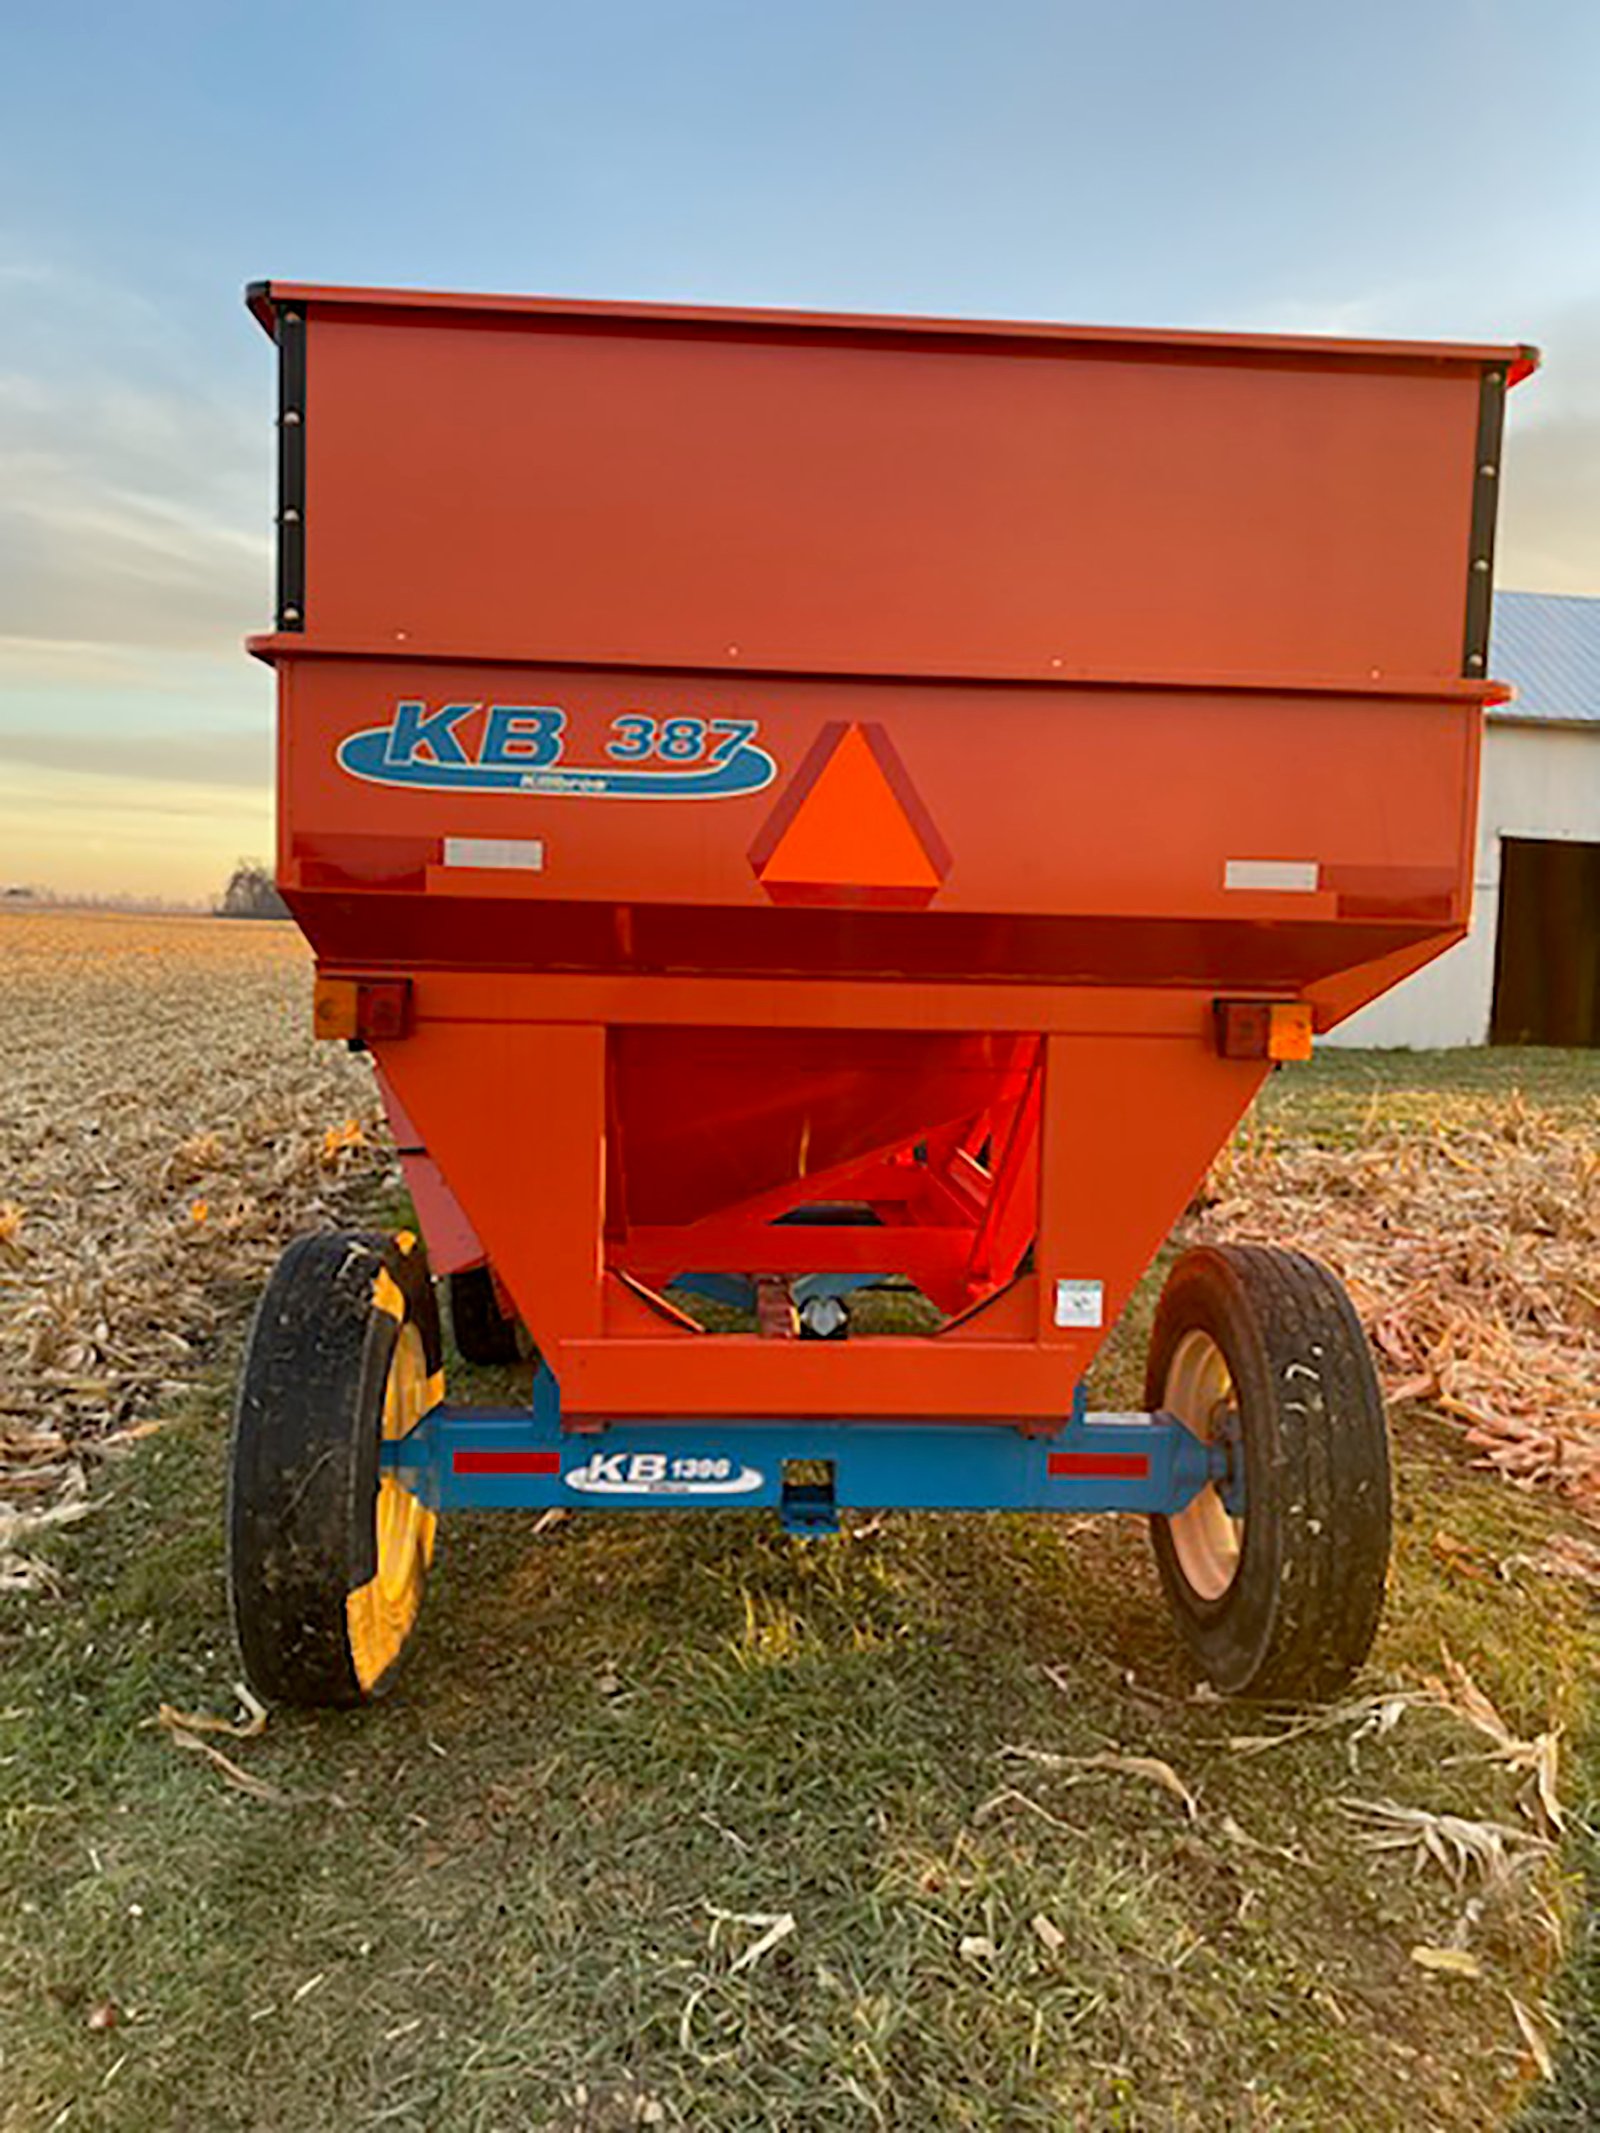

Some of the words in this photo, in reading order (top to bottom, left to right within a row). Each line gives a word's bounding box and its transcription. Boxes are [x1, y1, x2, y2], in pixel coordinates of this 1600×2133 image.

[384, 701, 567, 768] KB
[606, 714, 759, 762] 387
[588, 1454, 667, 1481] KB
